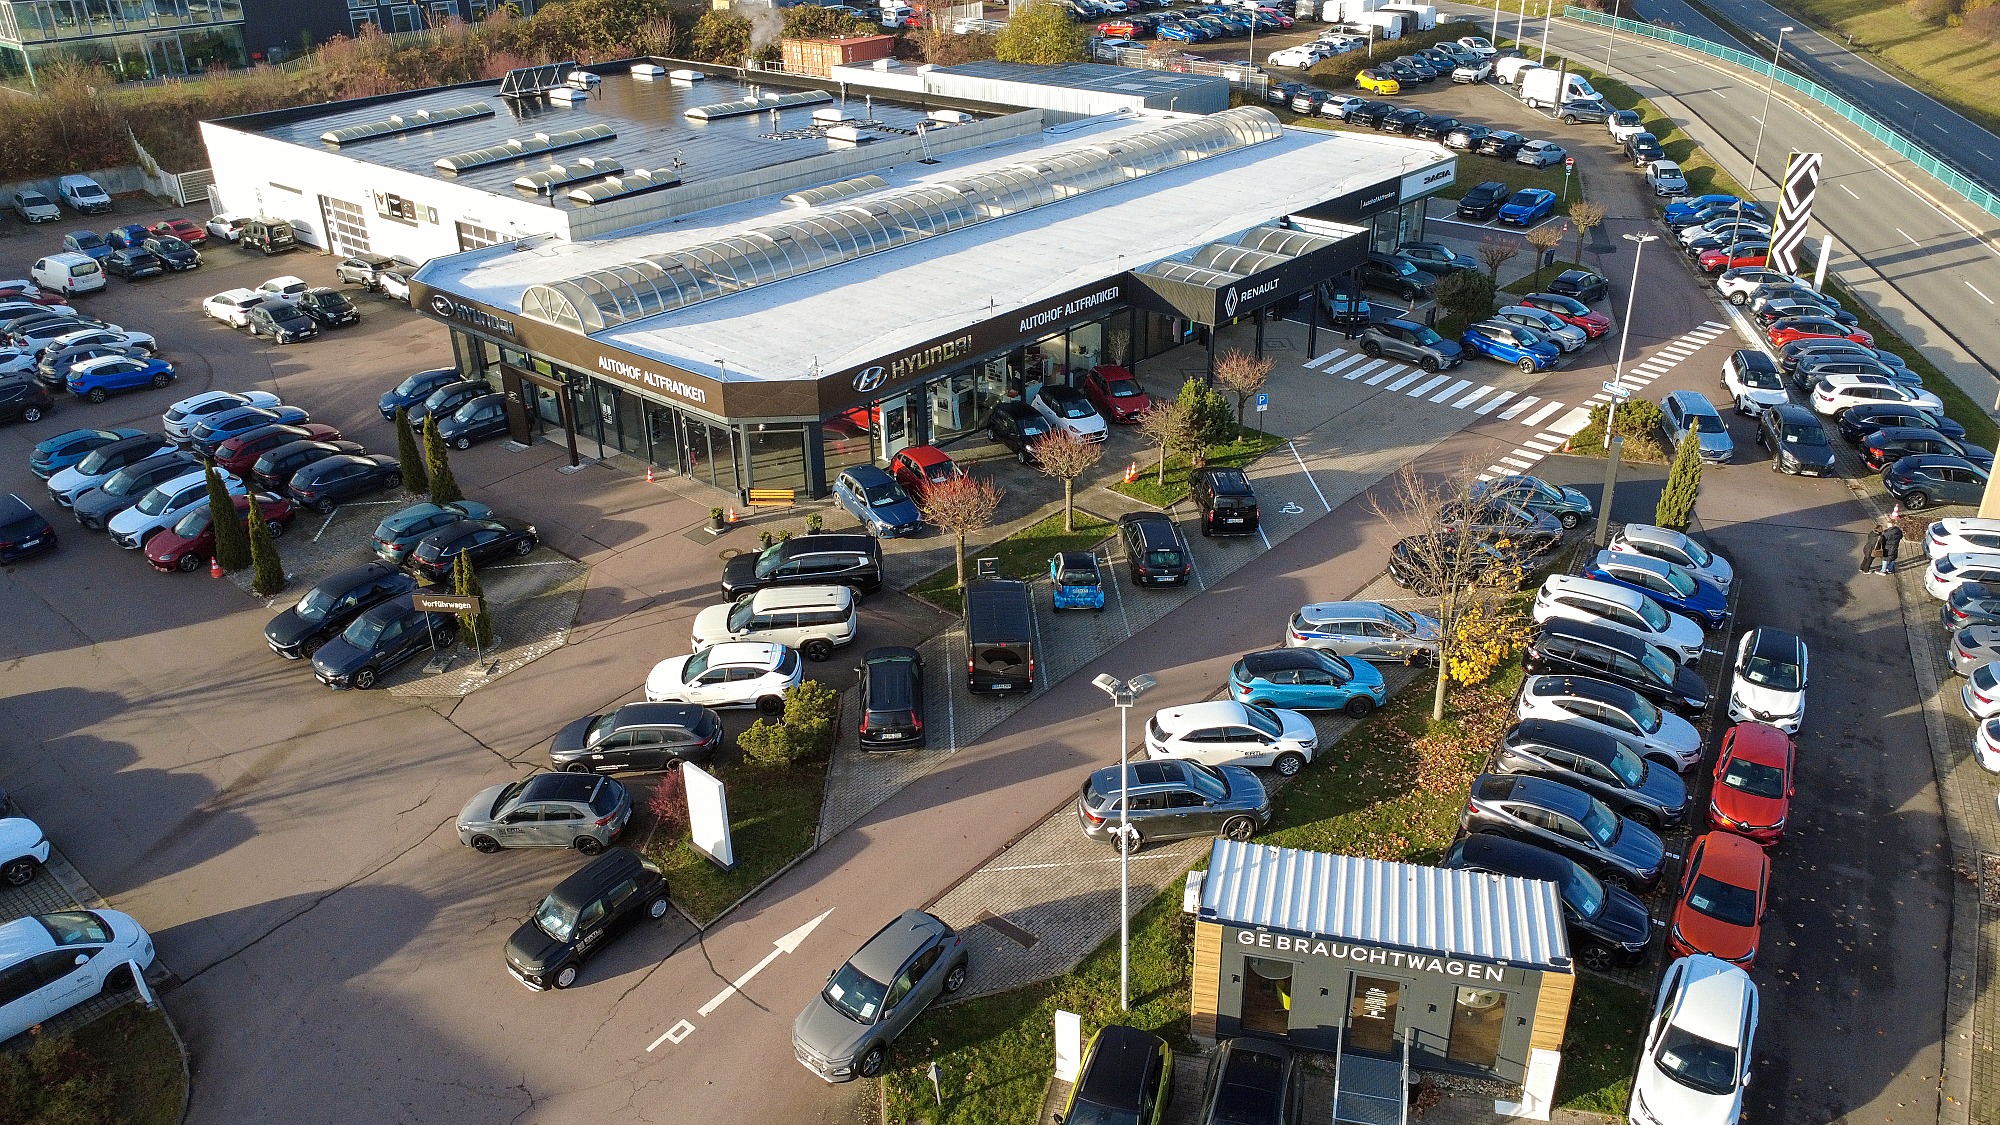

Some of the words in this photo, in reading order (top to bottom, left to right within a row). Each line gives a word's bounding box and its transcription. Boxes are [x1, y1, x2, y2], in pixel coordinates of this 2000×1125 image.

[1423, 169, 1451, 184] DACIA
[1019, 306, 1063, 333] AUTOHOF
[1064, 286, 1119, 316] ALTFRANKEN
[1240, 277, 1280, 302] RENAULT
[454, 302, 515, 337] HYUNDAI
[891, 334, 972, 379] HYUNDAI
[598, 355, 642, 381] AUTOHOF
[643, 370, 706, 404] ALTFRANKEN
[421, 599, 471, 610] Vorführwagen
[1237, 930, 1504, 982] GEBRAUCHTWAGEN
